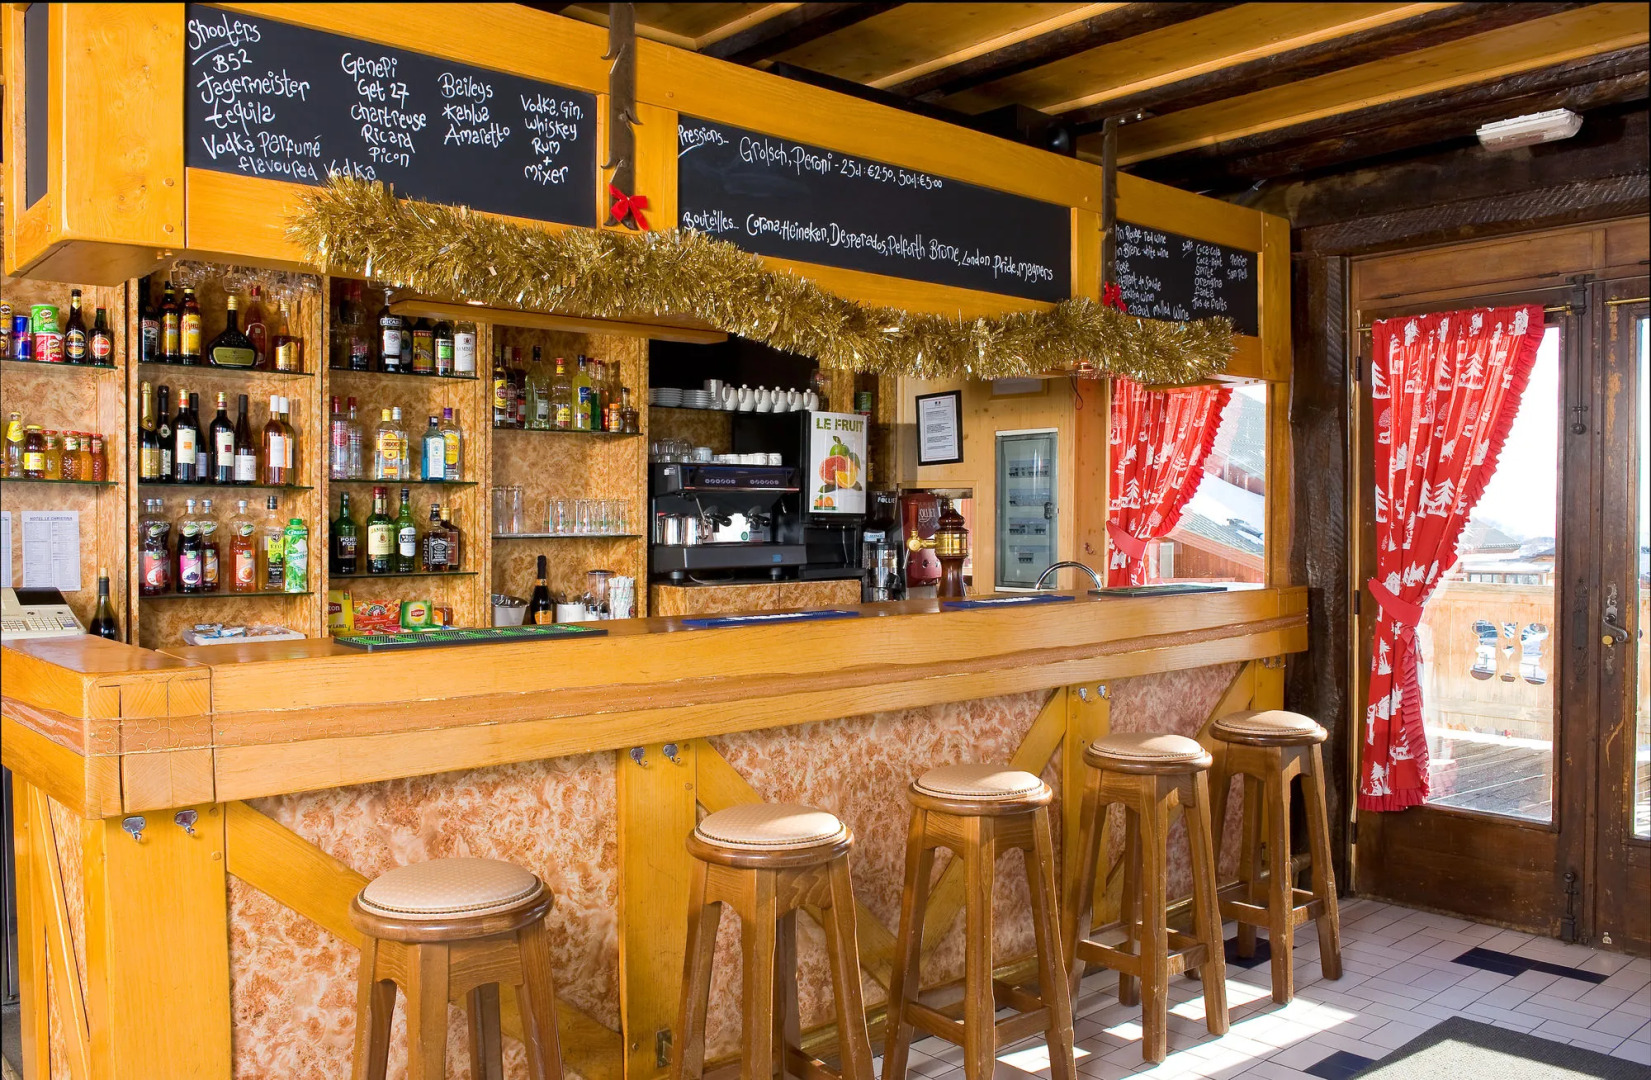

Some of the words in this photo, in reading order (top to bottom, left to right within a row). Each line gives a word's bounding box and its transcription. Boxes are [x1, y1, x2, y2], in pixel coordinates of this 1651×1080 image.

[188, 13, 261, 50] Shooters
[212, 48, 252, 73] B52
[196, 68, 310, 103] Jagermeister
[357, 79, 386, 102] Get
[390, 82, 410, 109] 27
[437, 72, 494, 104] Baileys
[441, 103, 490, 127] Kahlua
[202, 131, 255, 159] Vodka
[361, 123, 416, 154] Ricard
[444, 122, 510, 148] Amaretto
[531, 137, 561, 155] Rum
[238, 156, 318, 181] flavoured
[368, 146, 410, 168] Picon
[790, 146, 833, 175] Peroni
[887, 234, 926, 260] Pelforth
[962, 248, 991, 267] London
[816, 417, 832, 430] LE
[835, 418, 864, 432] FRUIT
